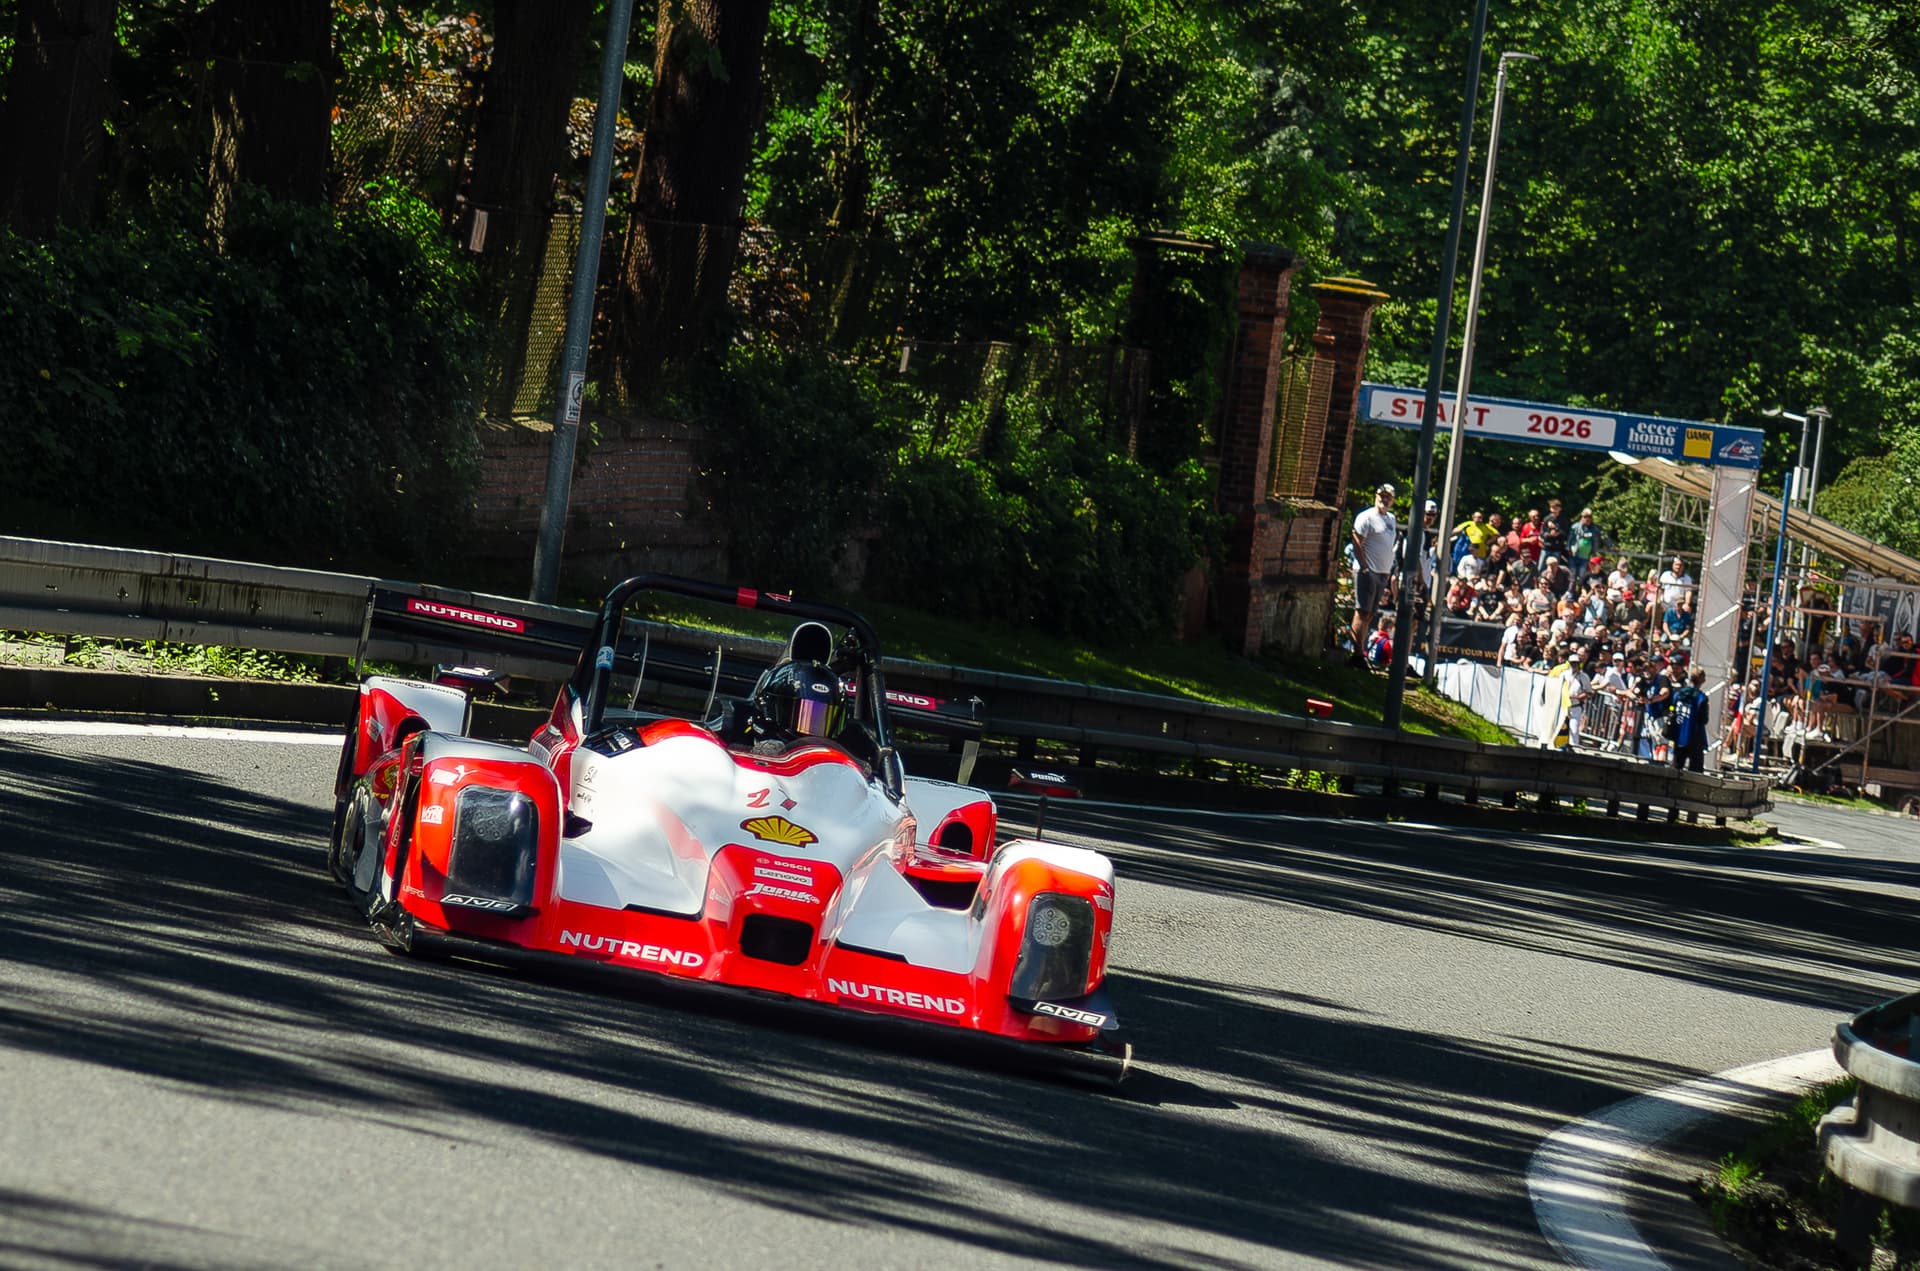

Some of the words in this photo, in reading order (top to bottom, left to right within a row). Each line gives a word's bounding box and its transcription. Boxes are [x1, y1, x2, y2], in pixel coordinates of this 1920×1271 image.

[1527, 414, 1592, 438] 2026
[1637, 422, 1677, 437] ecce
[1629, 427, 1675, 447] homo
[415, 602, 517, 628] NUTREND
[1484, 650, 1499, 659] WO
[845, 684, 930, 706] UEND
[759, 869, 808, 883] Lenovo
[774, 860, 812, 872] BOSCH
[560, 930, 703, 967] NUTREND
[828, 978, 965, 1015] NUTREND
